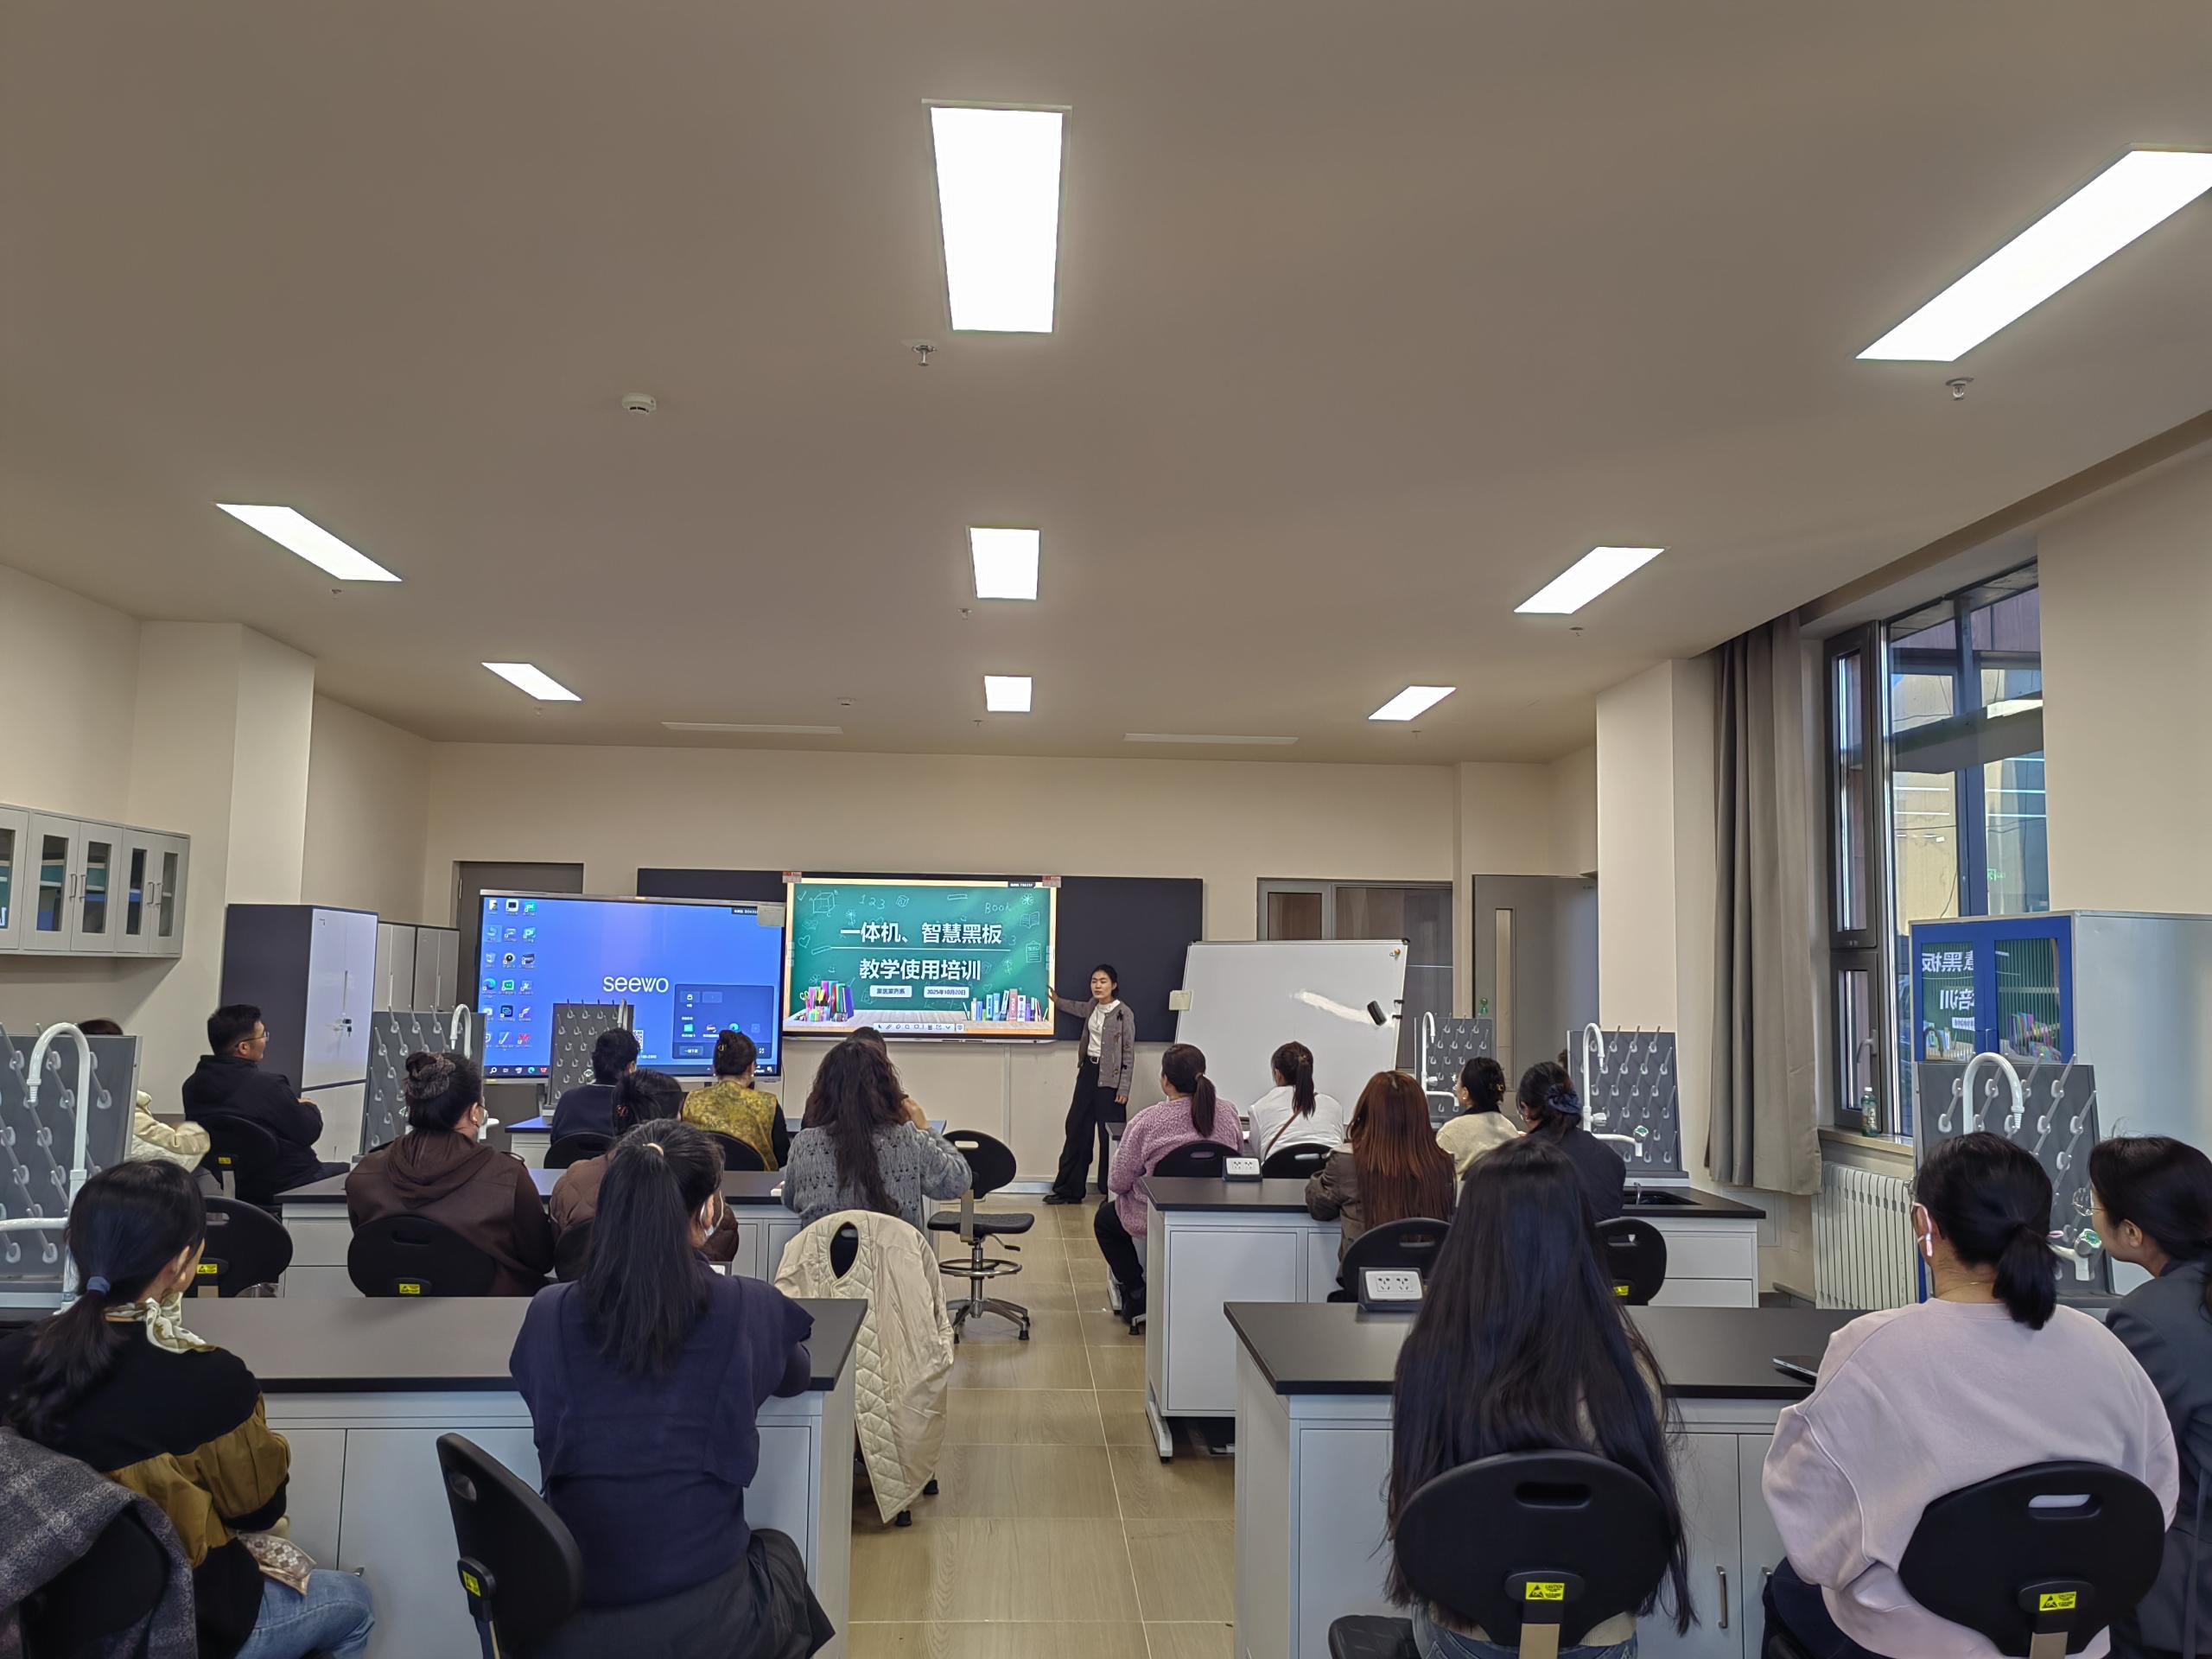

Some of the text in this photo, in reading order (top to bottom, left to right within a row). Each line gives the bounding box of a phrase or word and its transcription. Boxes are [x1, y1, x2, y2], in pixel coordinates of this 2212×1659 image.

[841, 921, 1002, 944] 一体机、智慧黑板
[860, 958, 982, 981] 教学使用培训
[603, 976, 669, 993] seewo
